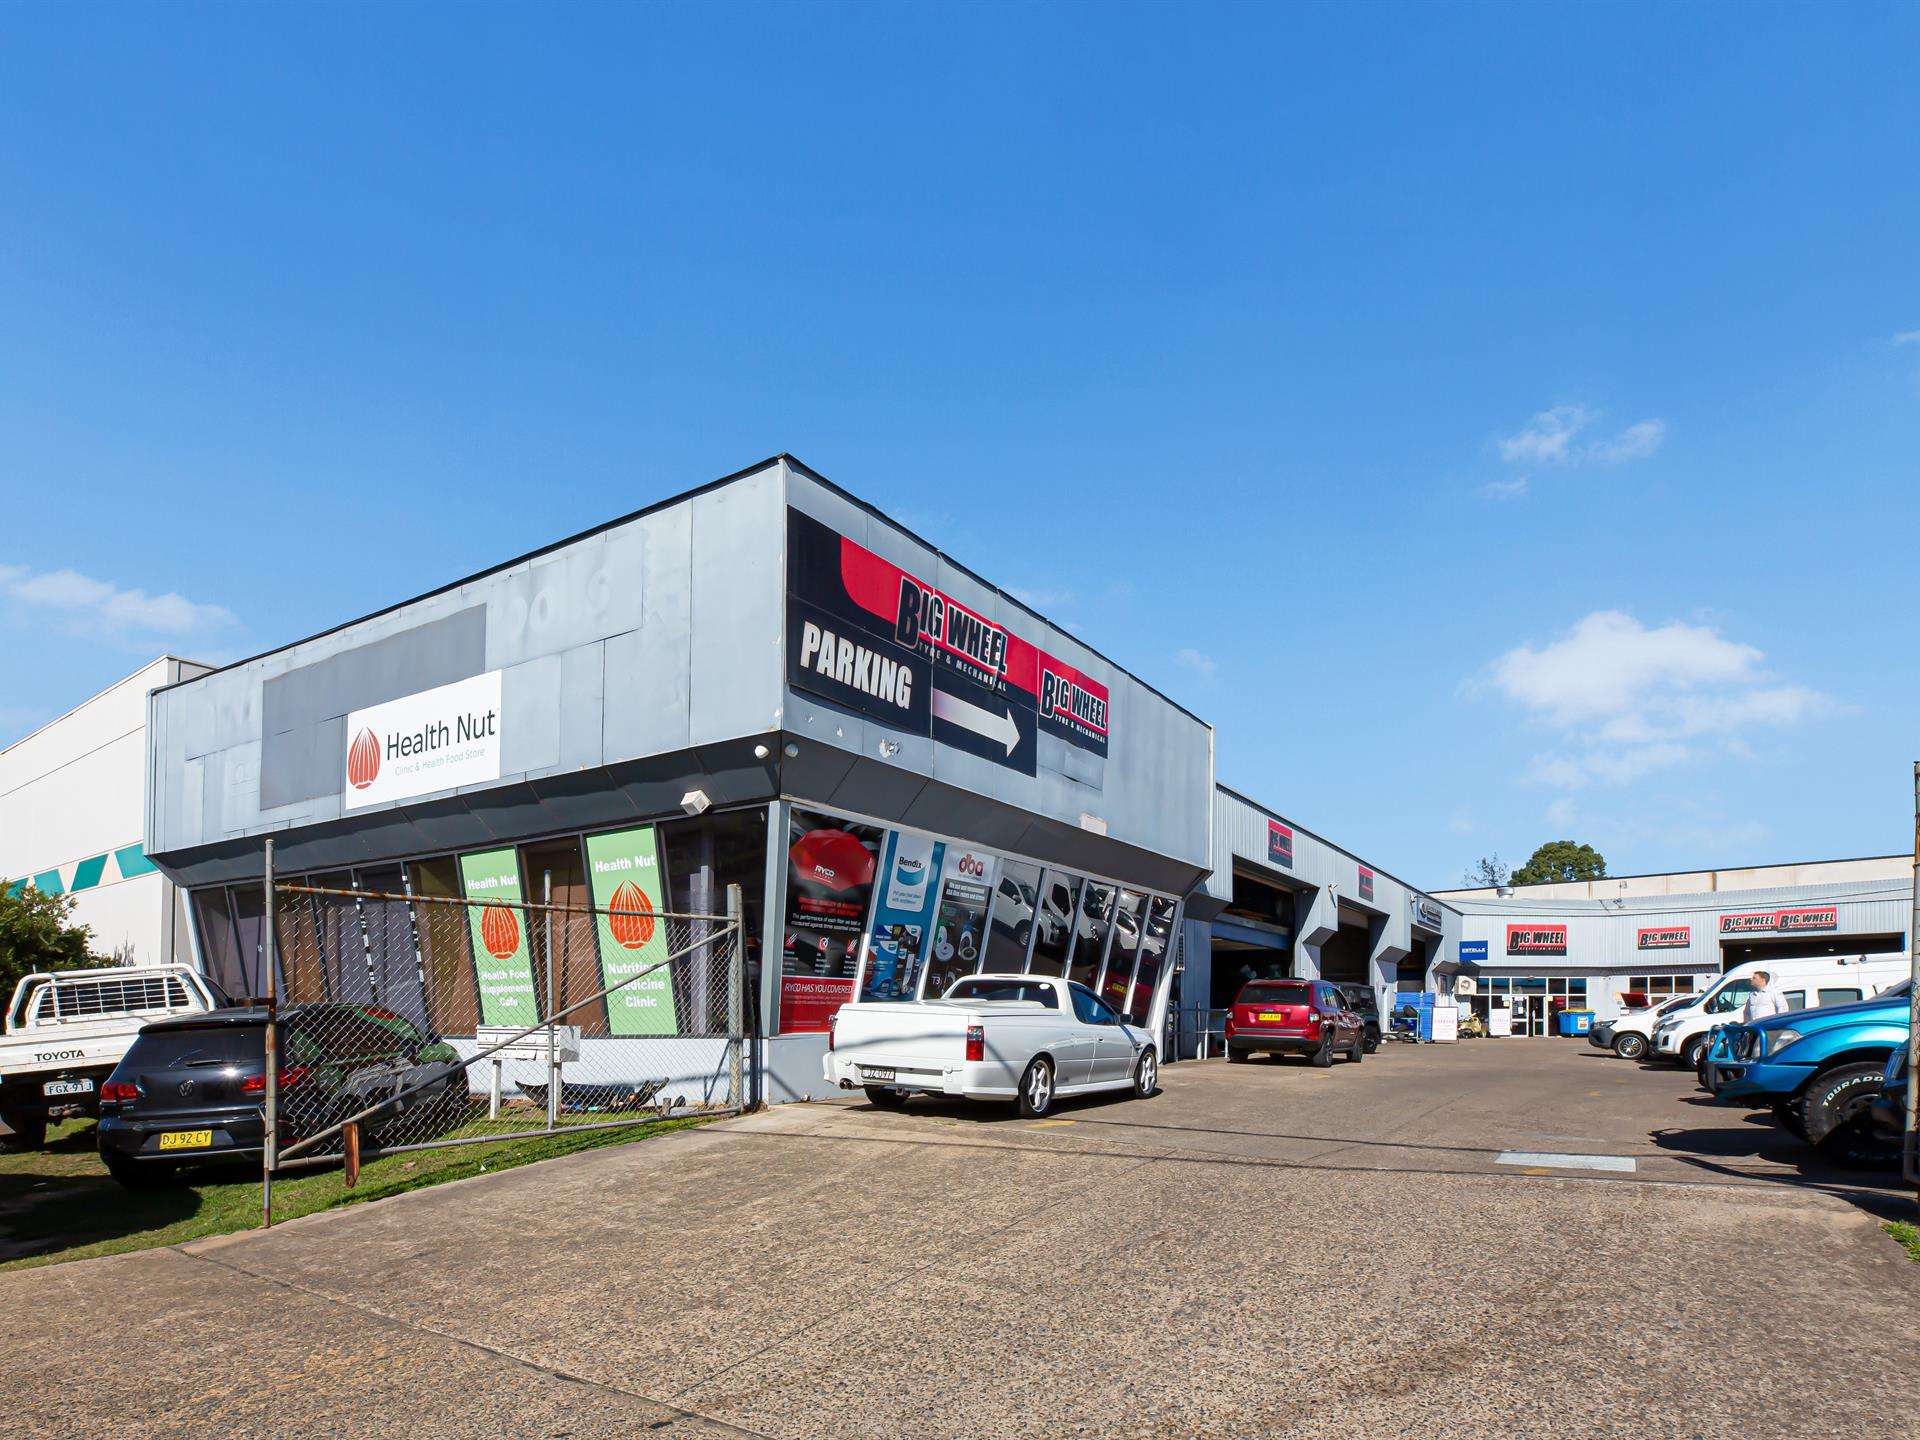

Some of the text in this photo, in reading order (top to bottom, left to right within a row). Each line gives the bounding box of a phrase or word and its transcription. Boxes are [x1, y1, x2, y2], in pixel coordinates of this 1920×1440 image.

[895, 574, 1008, 675] BIG WHEEL
[919, 642, 941, 660] TYRE
[945, 654, 952, 665] &
[800, 620, 913, 709] PARKING
[1040, 668, 1107, 731] BIG WHEEL
[387, 710, 495, 760] Health Nut
[395, 748, 486, 776] Clinic & Health Food Store
[595, 855, 656, 873] Health Nut
[899, 857, 922, 868] Bendix
[815, 865, 835, 877] RYCO
[468, 874, 518, 890] Health Nut
[1721, 915, 1774, 931] BIG WHEEL
[1779, 912, 1834, 929] BIG WHEEL
[1508, 931, 1564, 950] BIG WHEEL
[1639, 931, 1688, 946] BIG WHEEL
[509, 969, 529, 979] Food
[801, 984, 814, 992] HAS
[815, 984, 827, 992] YOU
[626, 996, 657, 1008] Clinic
[34, 1049, 86, 1061] TOYOTA
[1822, 1076, 1884, 1107] TOURADO
[162, 1132, 209, 1145] DJ 92 CY
